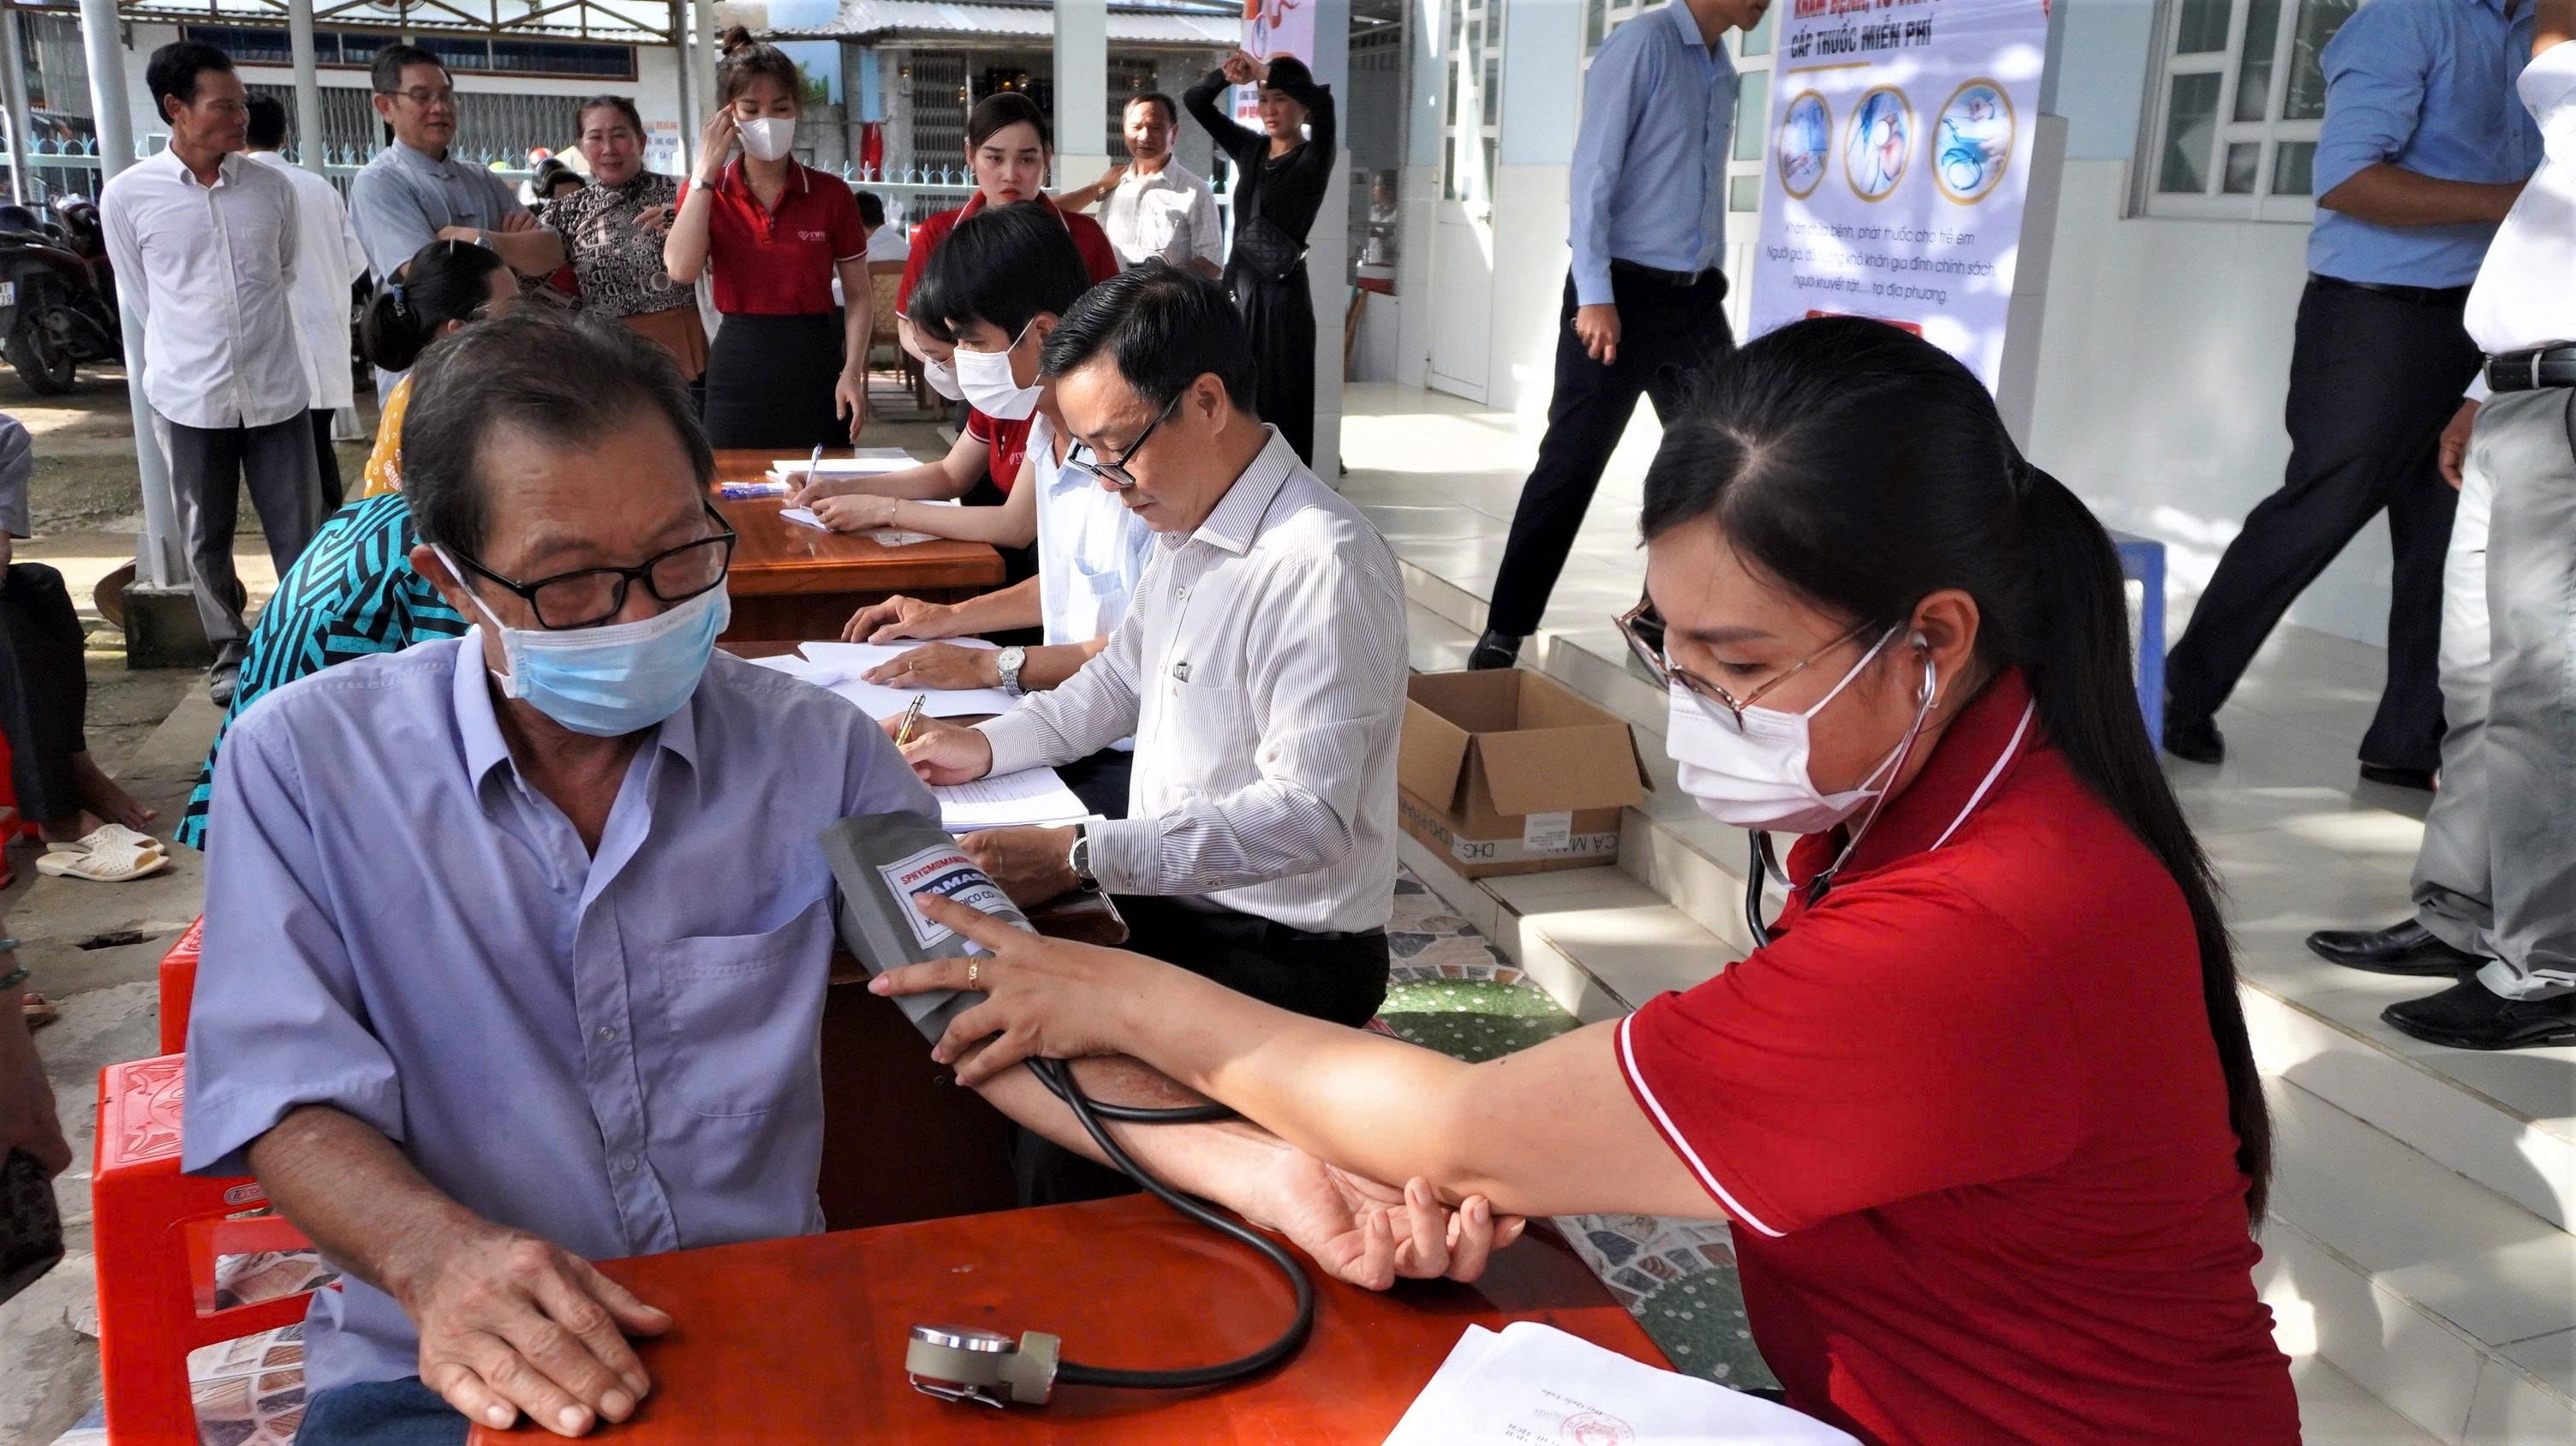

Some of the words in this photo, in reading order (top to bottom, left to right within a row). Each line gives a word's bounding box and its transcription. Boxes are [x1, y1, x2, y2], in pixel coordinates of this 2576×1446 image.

[1816, 19, 1857, 55] THUỐC
[1904, 12, 1935, 47] PHÍ
[1915, 229, 1936, 243] cho
[1956, 233, 1975, 246] em
[1891, 257, 1908, 272] gia
